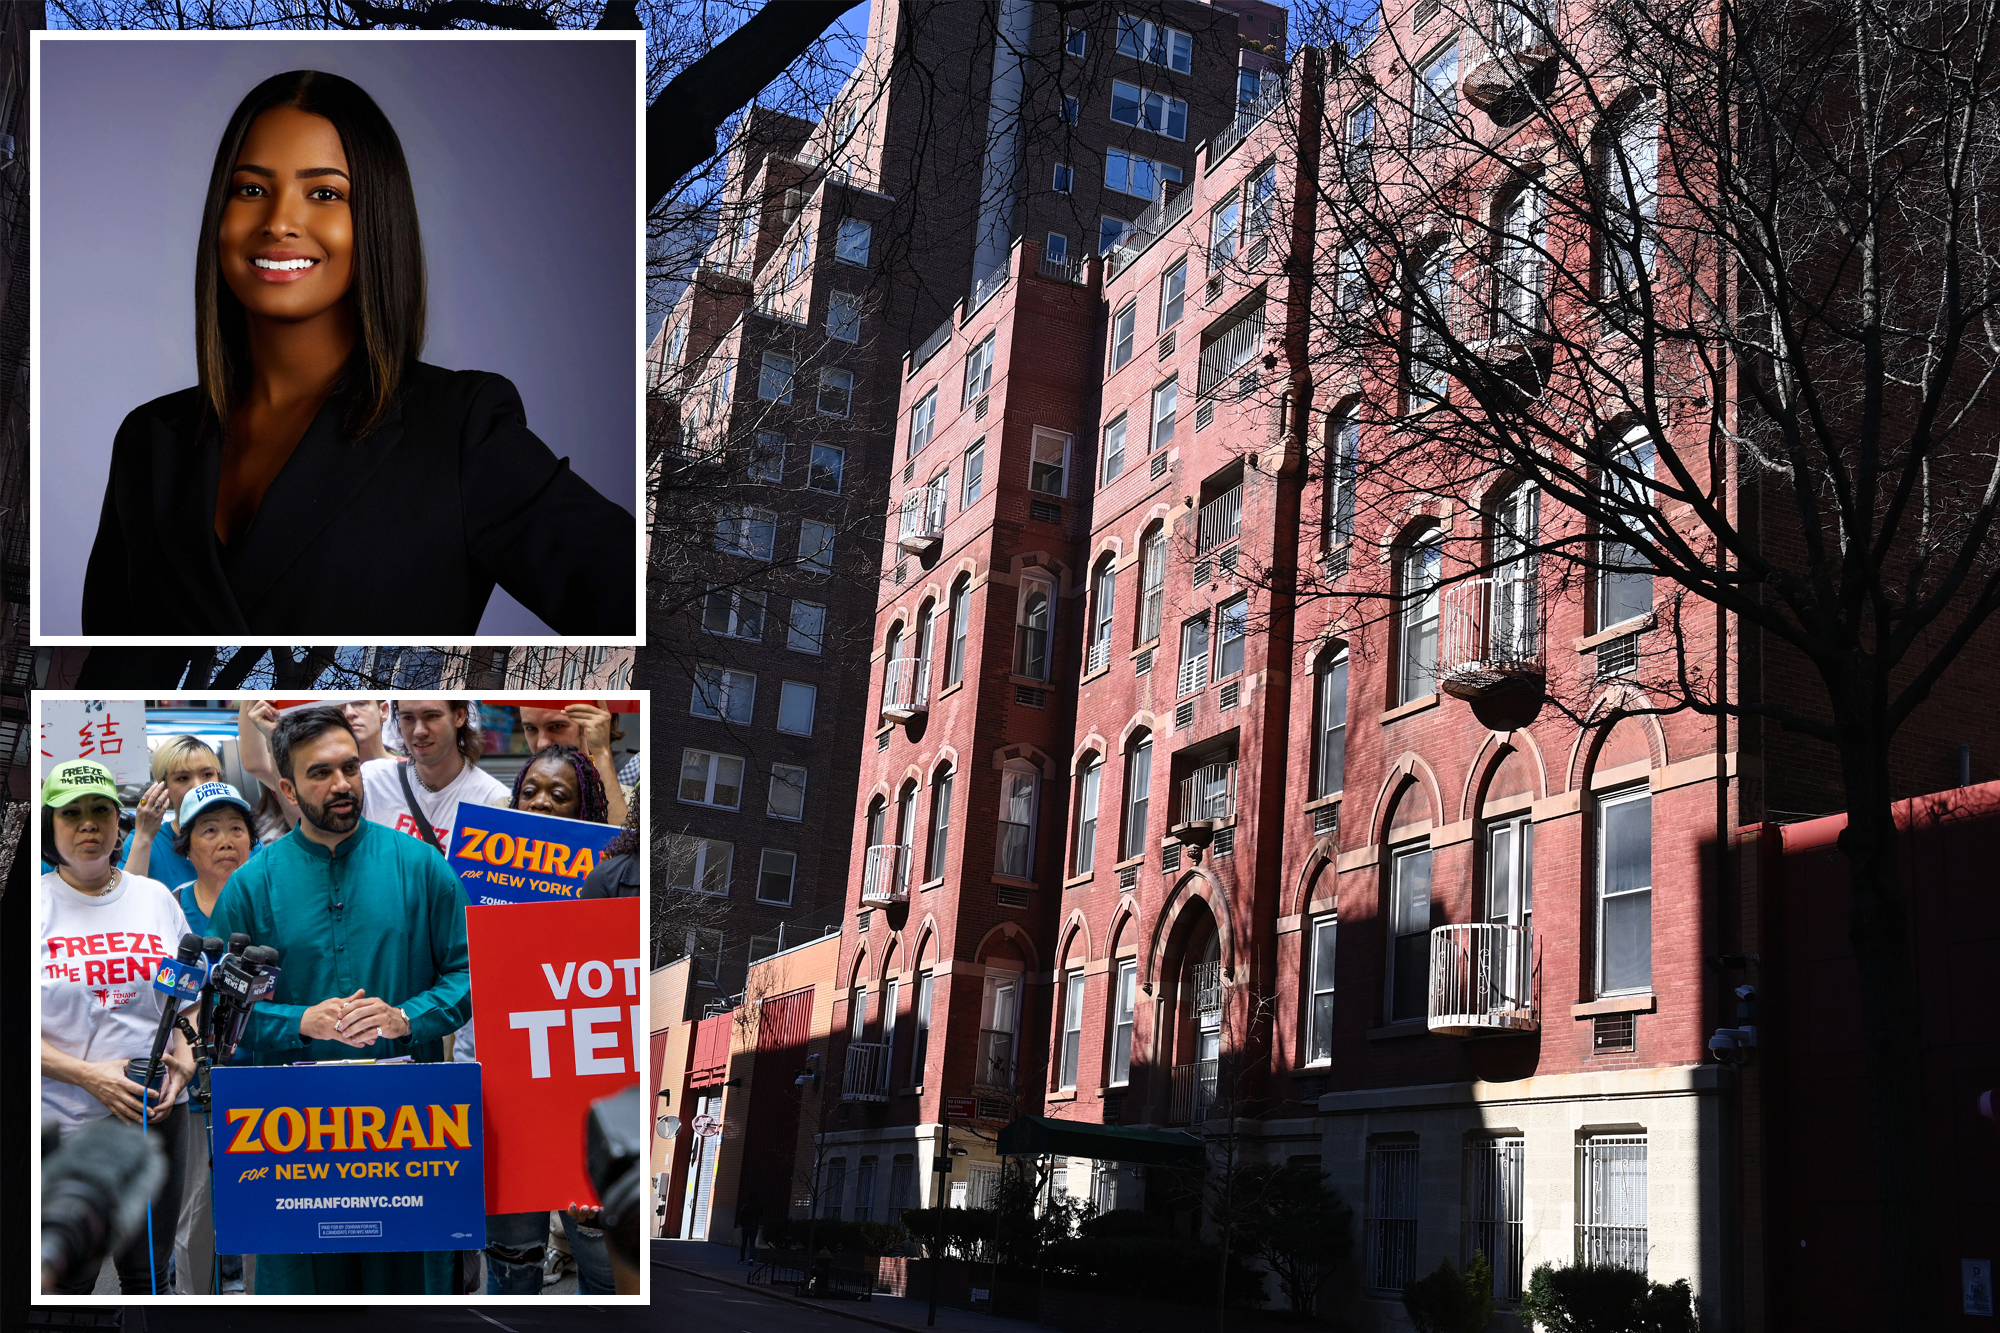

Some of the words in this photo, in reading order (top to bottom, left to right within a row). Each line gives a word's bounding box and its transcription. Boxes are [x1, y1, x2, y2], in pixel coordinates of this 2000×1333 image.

[62, 765, 103, 778] FREEZE
[60, 777, 74, 785] THE
[196, 788, 232, 802] VOICE
[455, 827, 605, 880] ZOHRA
[460, 870, 483, 879] FOR
[486, 871, 526, 888] NEW
[529, 879, 573, 897] YORK
[46, 931, 168, 959] FREEZE
[45, 963, 80, 982] THE
[268, 975, 276, 985] 5
[178, 973, 191, 988] 4
[223, 976, 239, 990] NEWS
[113, 991, 137, 999] TENANT
[509, 1005, 640, 1079] TE
[224, 1103, 473, 1155] ZOHRAN
[238, 1166, 269, 1183] FOR
[275, 1163, 330, 1180] NEW
[335, 1161, 400, 1179] YORK
[405, 1160, 460, 1177] CITY
[275, 1195, 424, 1210] ZOHRANFORNYC.COM
